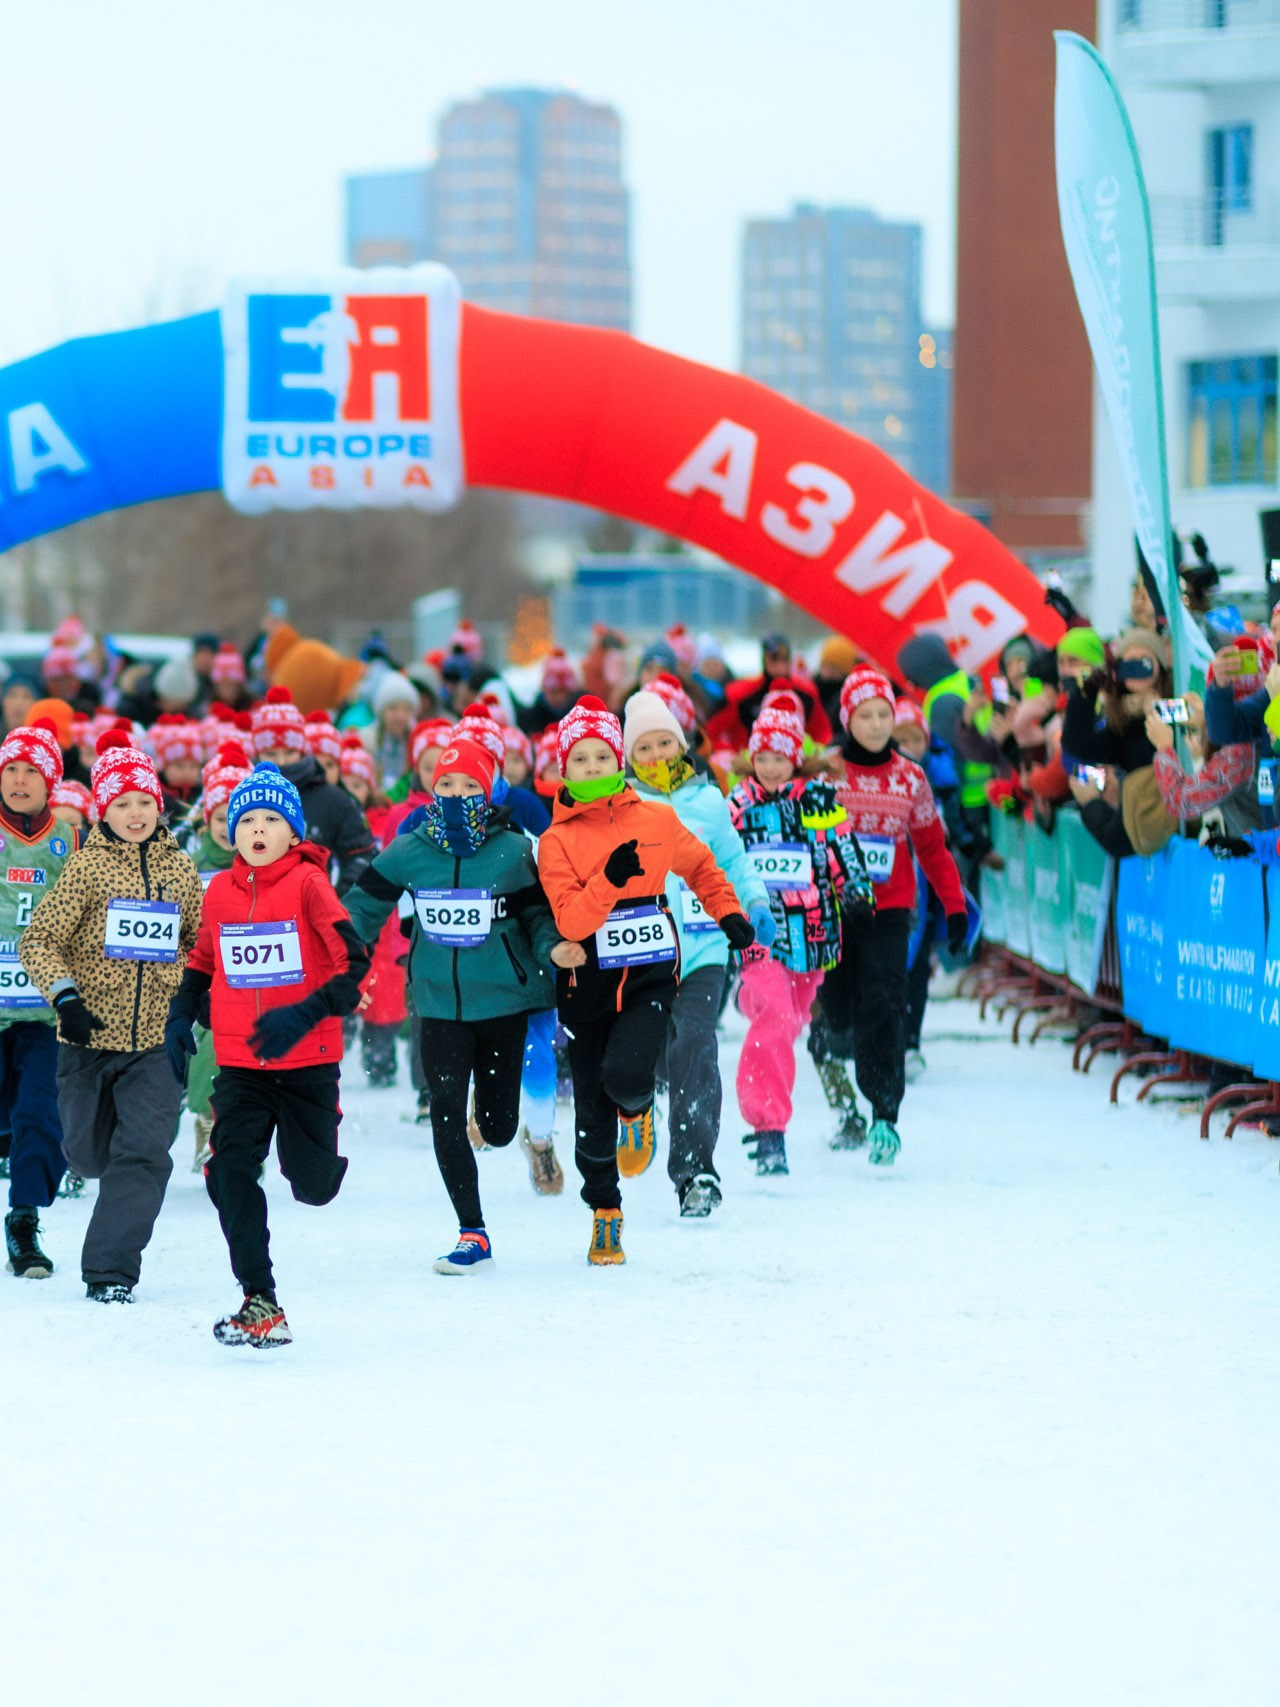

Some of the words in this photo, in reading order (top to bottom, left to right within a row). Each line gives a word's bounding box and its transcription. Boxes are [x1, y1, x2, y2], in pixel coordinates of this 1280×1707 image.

[247, 435, 432, 458] EUROPE
[249, 464, 433, 489] ASIA
[665, 417, 1029, 673] АЗИЯ
[232, 788, 283, 814] SOCHI
[753, 857, 802, 873] 5027
[866, 850, 888, 866] 06
[7, 868, 46, 884] BROZEX
[425, 907, 481, 926] 5028
[117, 918, 173, 940] 5024
[607, 923, 664, 947] 5058
[231, 943, 285, 965] 5071
[0, 971, 33, 988] 50
